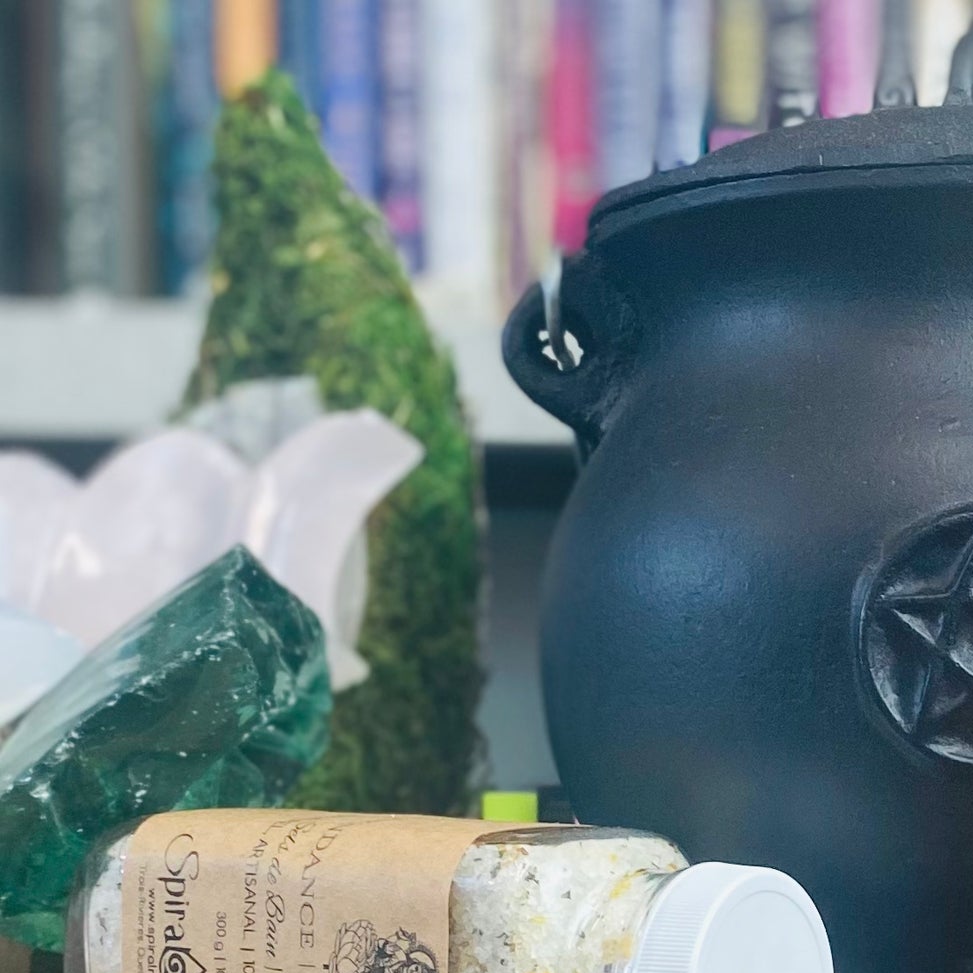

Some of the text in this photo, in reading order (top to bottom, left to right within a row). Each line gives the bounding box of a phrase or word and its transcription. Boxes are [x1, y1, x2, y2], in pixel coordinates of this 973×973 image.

[267, 857, 282, 885] de
[215, 911, 227, 938] 300
[265, 890, 286, 958] Bain
[213, 940, 225, 952] g
